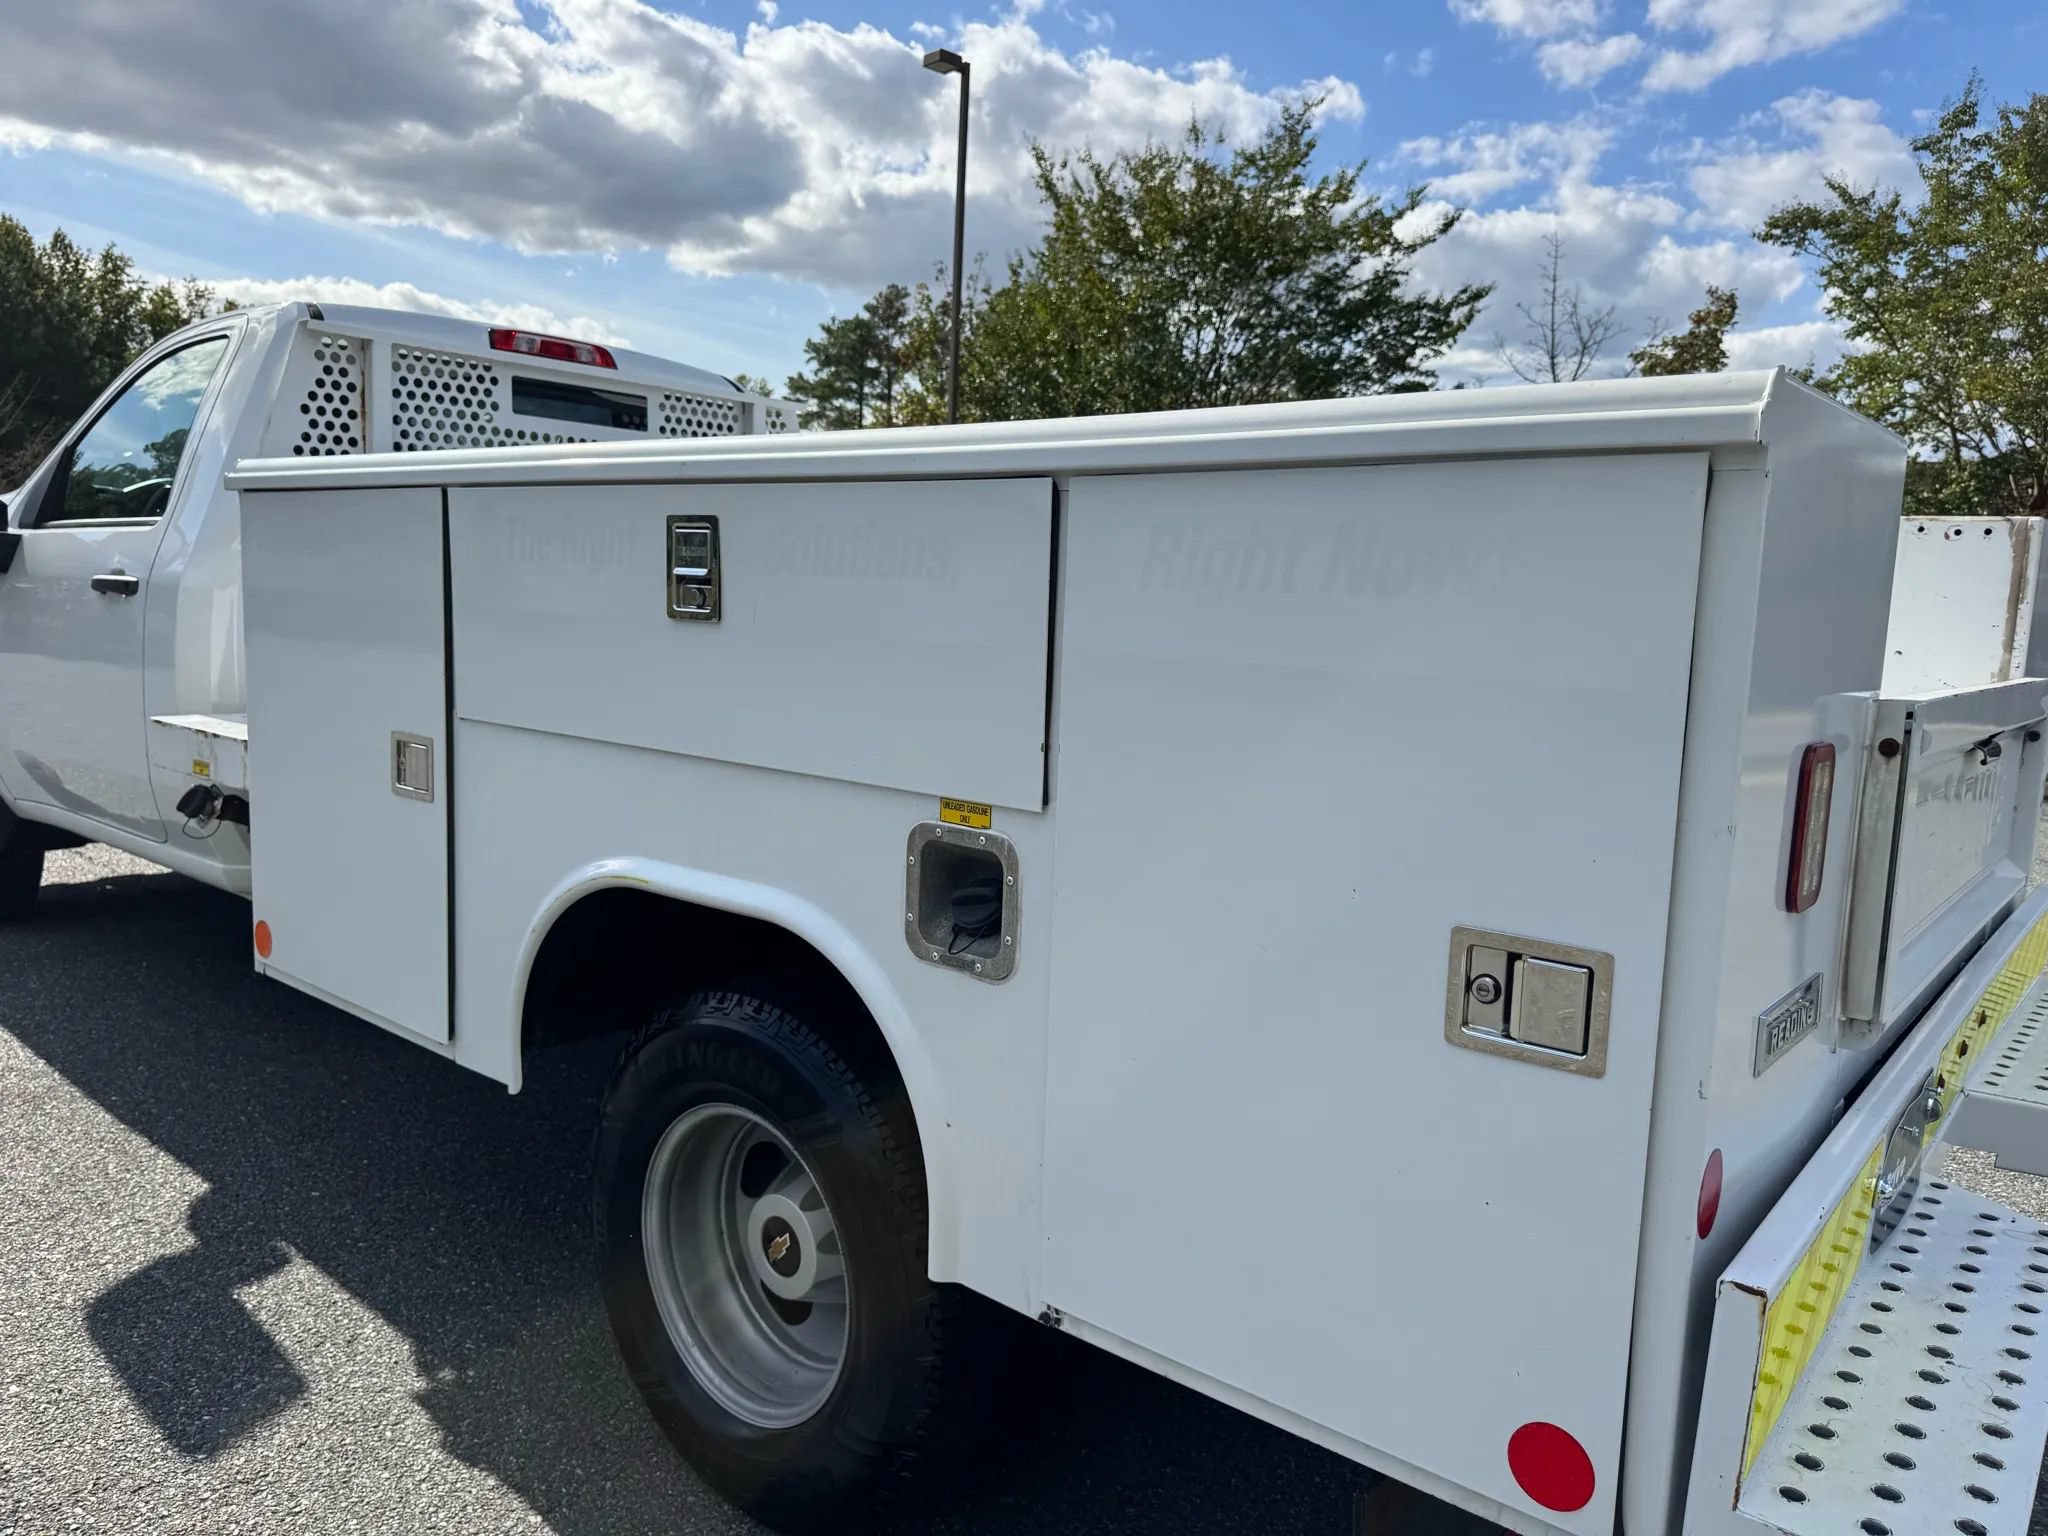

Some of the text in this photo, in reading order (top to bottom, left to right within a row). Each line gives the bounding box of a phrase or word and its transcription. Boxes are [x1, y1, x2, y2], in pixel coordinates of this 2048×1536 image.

[1140, 520, 1310, 608] Right
[942, 801, 989, 816] UNLEADED GASOLINE
[959, 814, 970, 823] ONLY
[1769, 1004, 1814, 1054] READING
[636, 1040, 781, 1099] ANGLER
